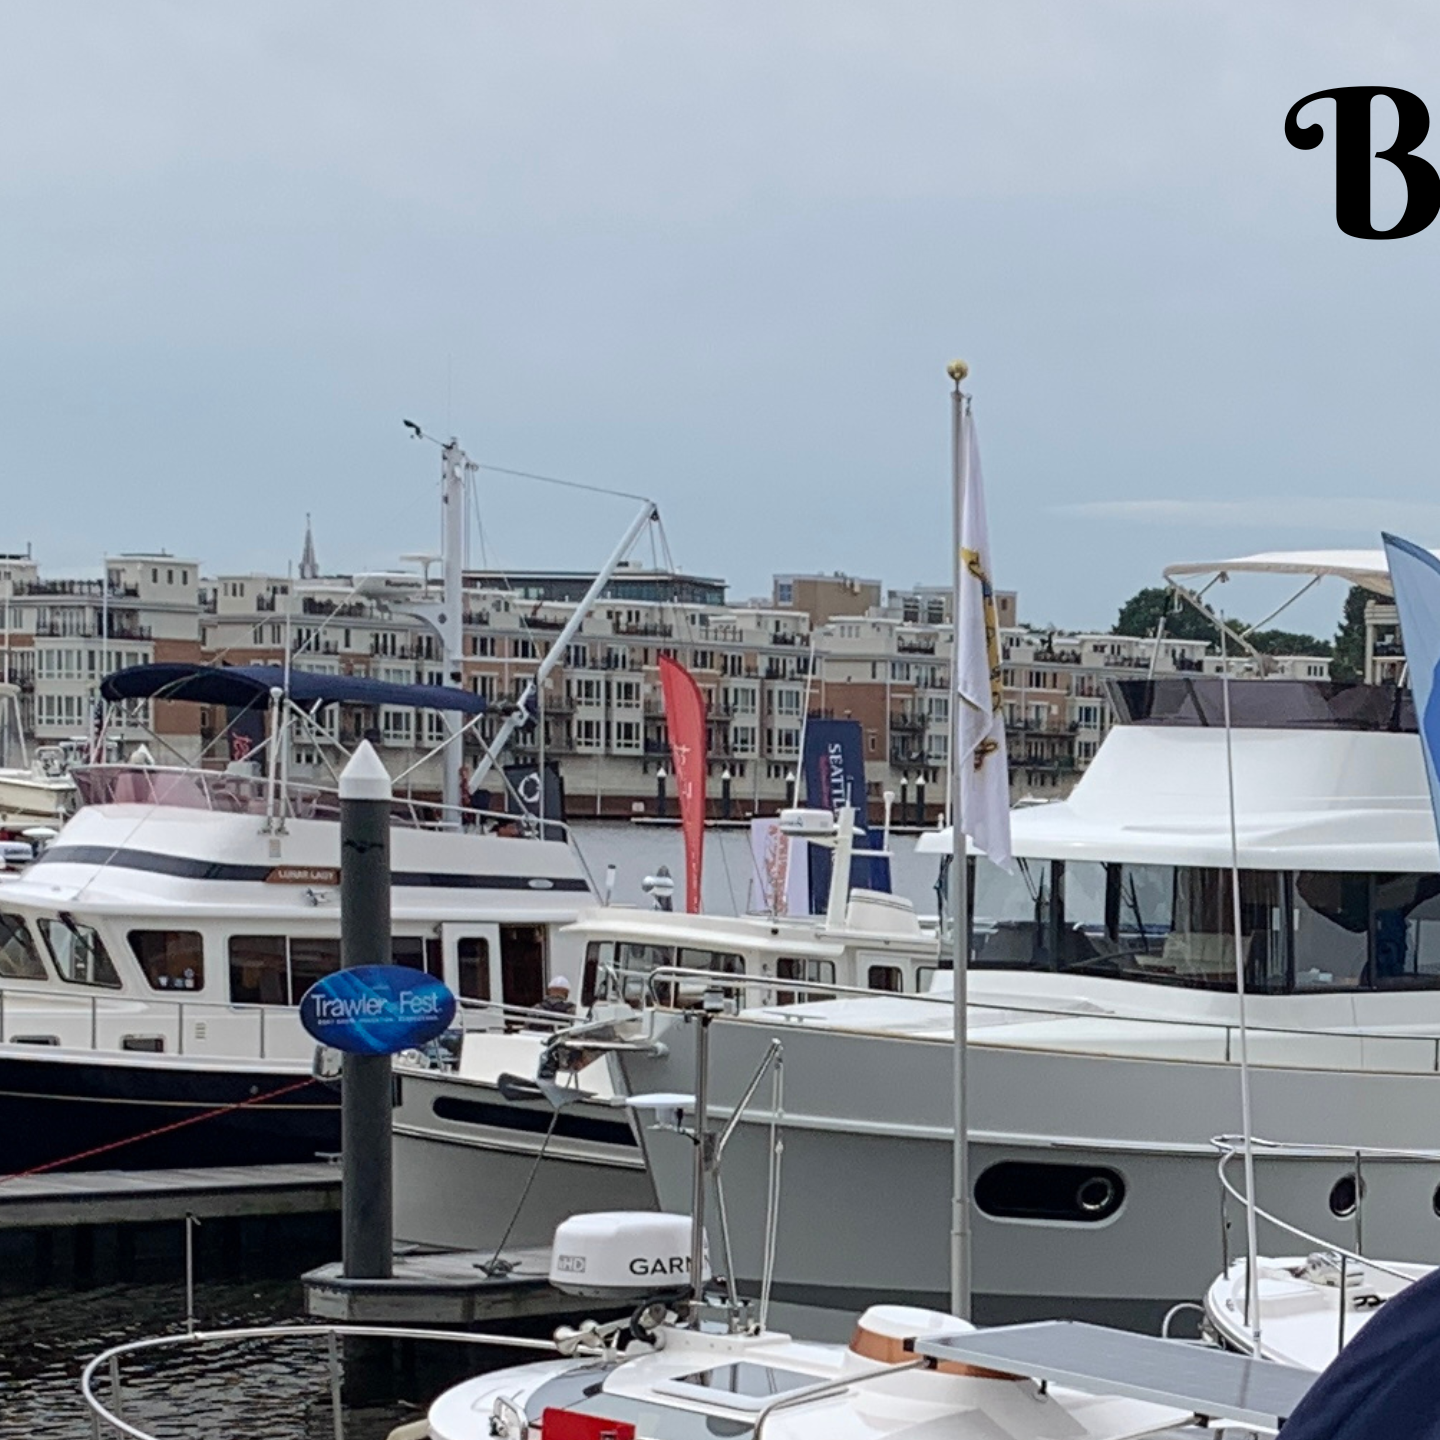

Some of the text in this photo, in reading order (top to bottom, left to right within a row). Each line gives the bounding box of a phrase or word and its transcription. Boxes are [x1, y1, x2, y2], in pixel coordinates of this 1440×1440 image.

[828, 743, 847, 817] SEATTL
[310, 990, 440, 1019] Trawler Fest
[629, 1256, 697, 1276] GAR
